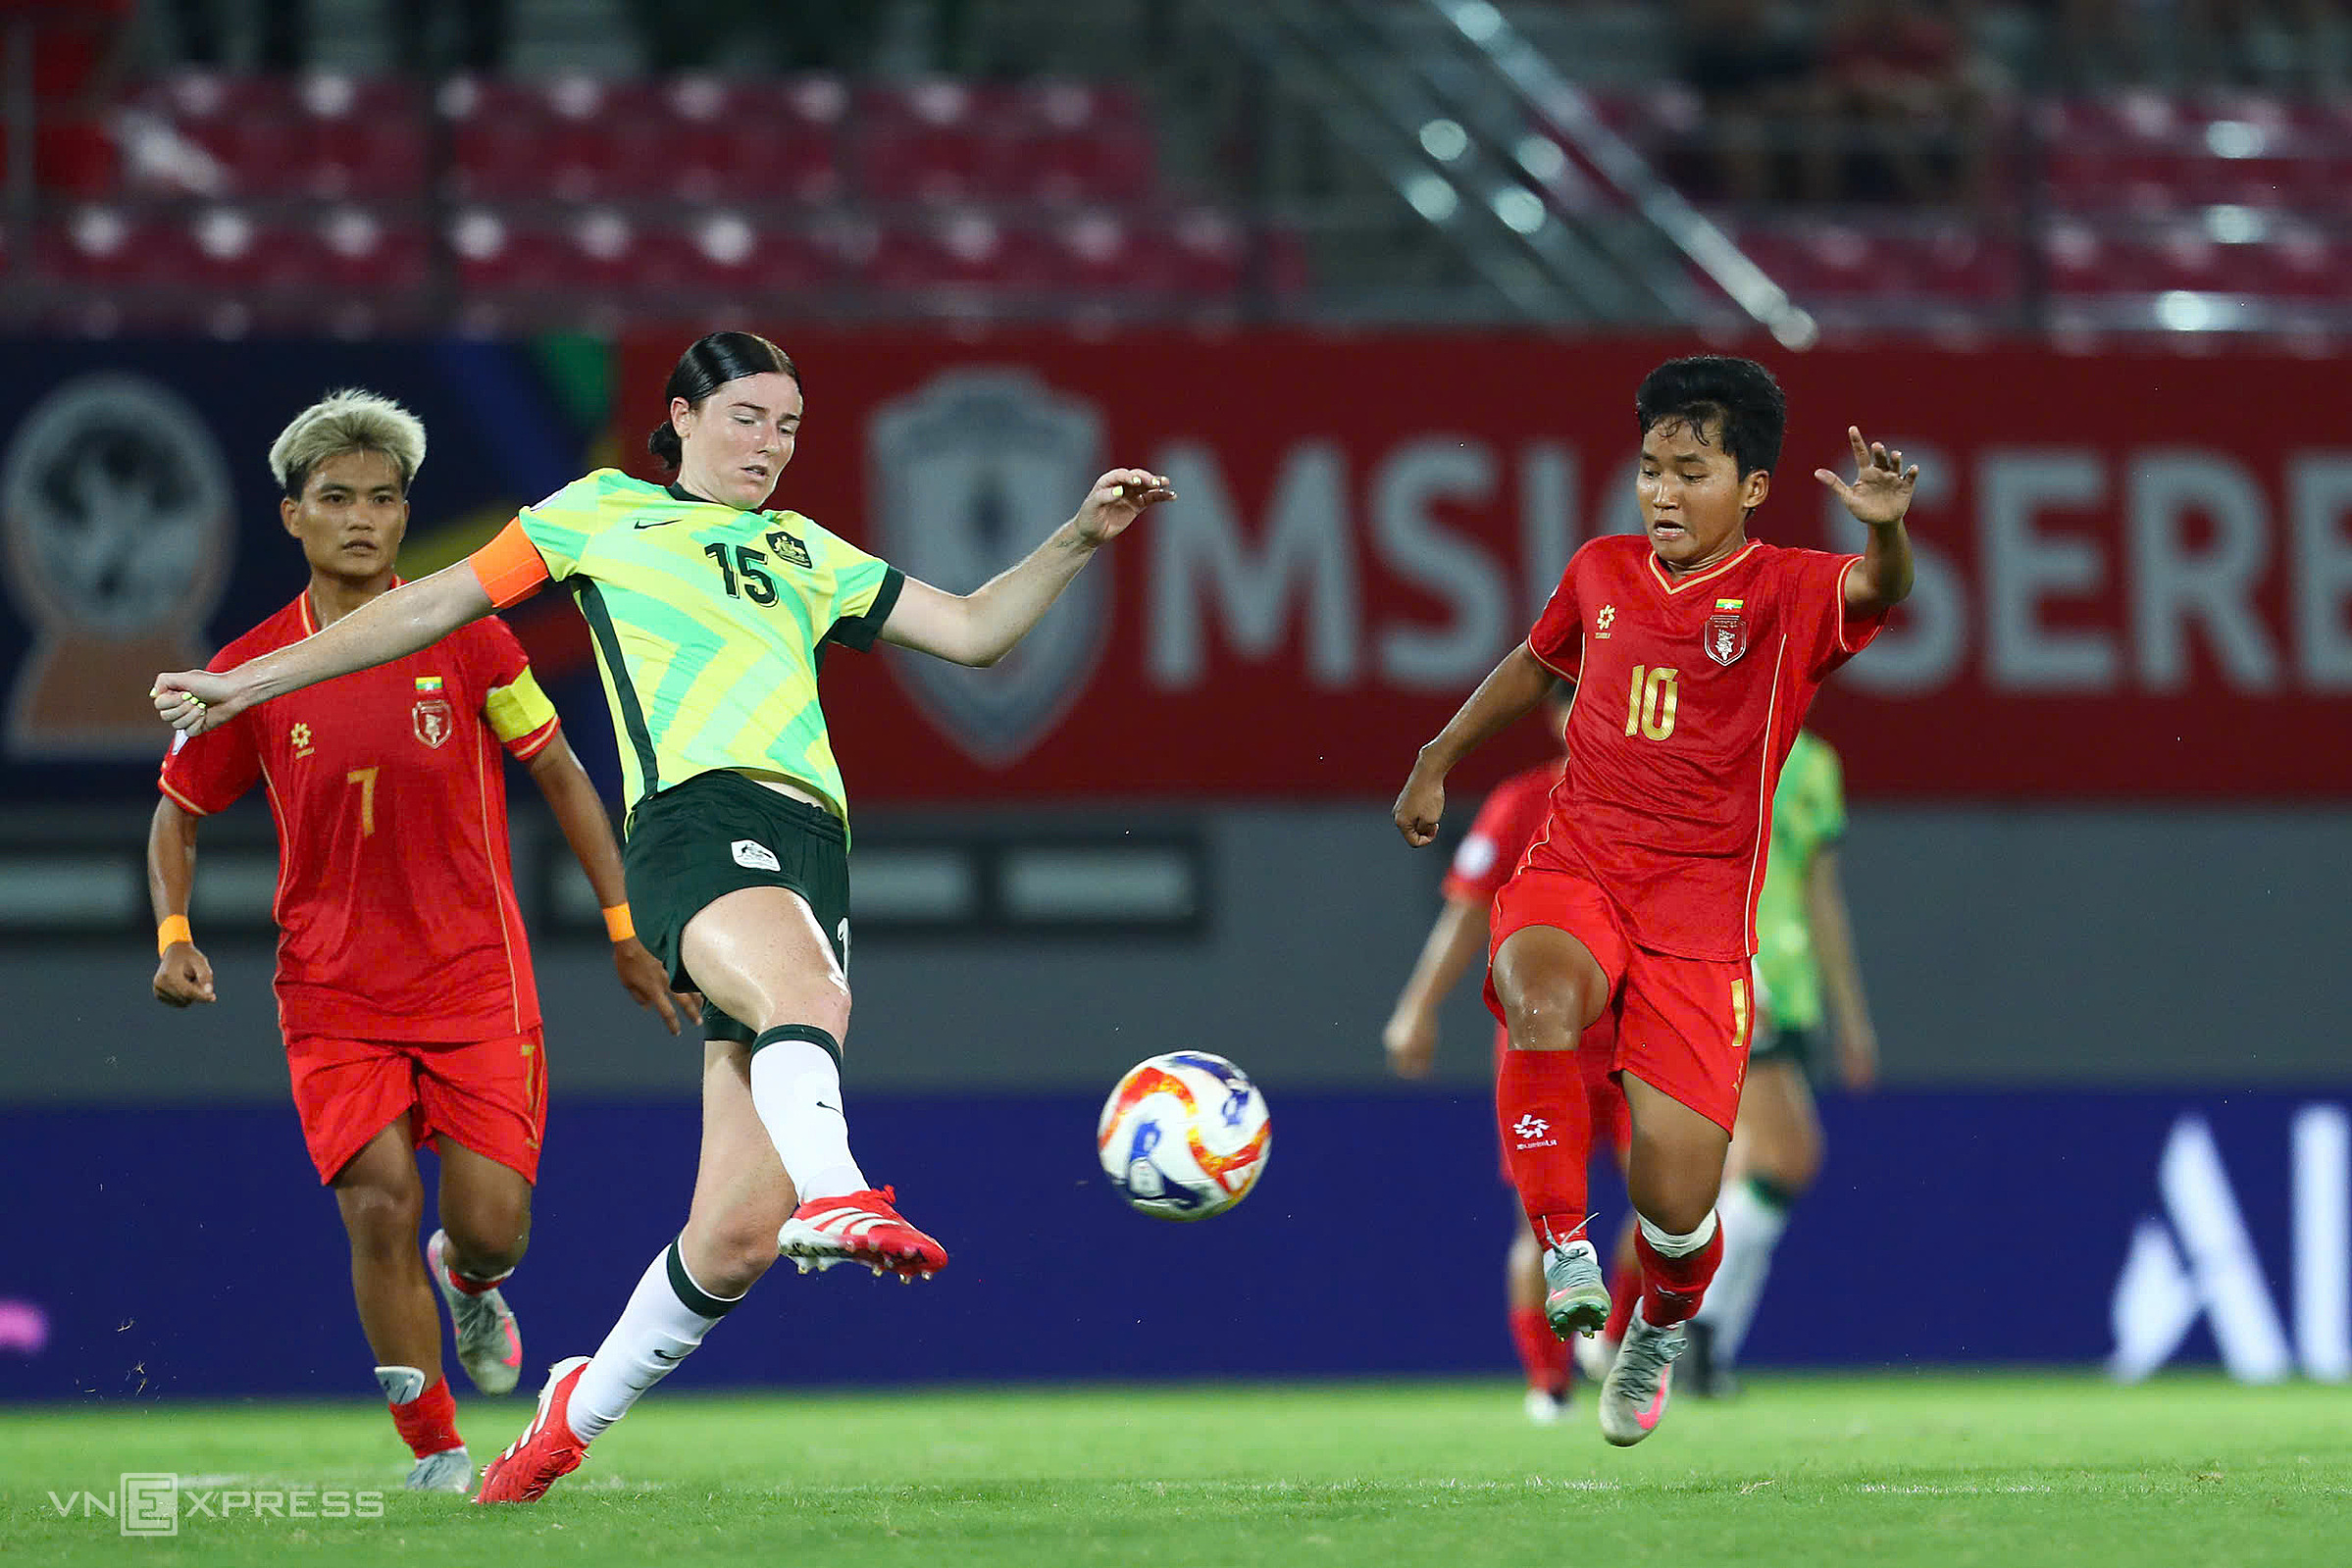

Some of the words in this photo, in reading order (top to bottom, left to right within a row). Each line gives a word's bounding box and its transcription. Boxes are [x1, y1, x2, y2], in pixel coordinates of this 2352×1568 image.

[704, 542, 779, 608] 15
[1150, 435, 1642, 684] MSI
[1625, 664, 1678, 741] 10
[347, 766, 379, 838] 7
